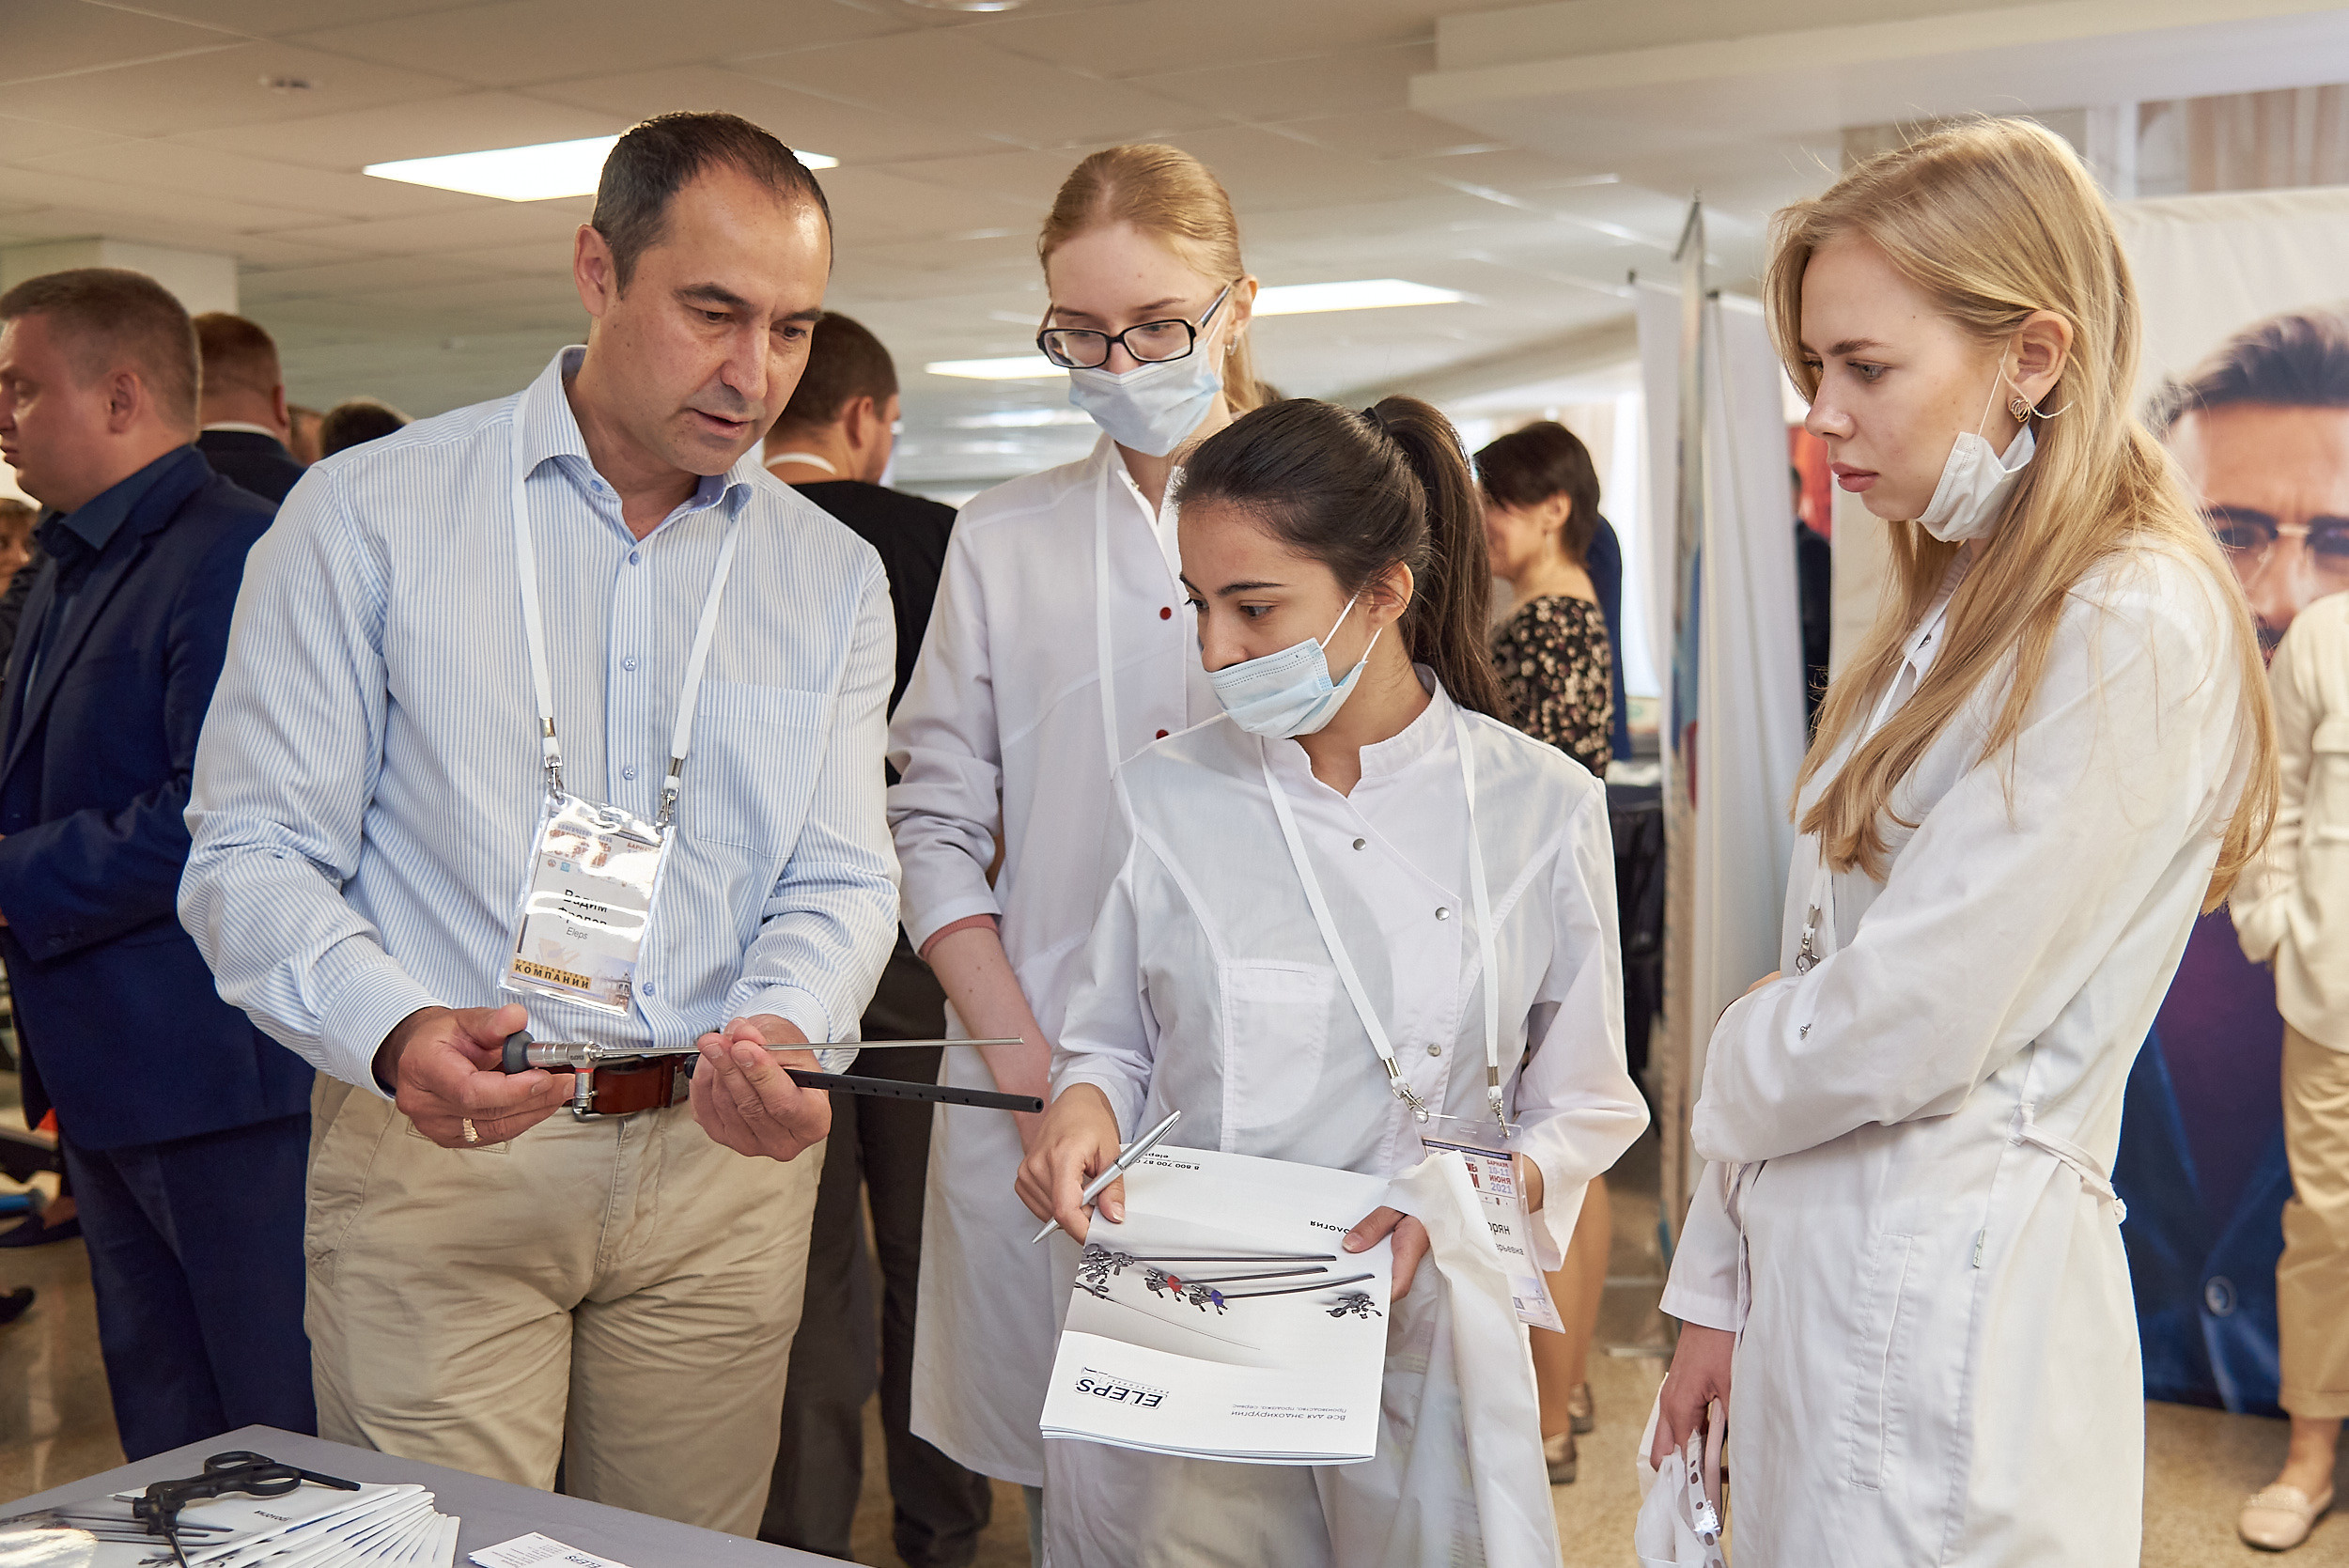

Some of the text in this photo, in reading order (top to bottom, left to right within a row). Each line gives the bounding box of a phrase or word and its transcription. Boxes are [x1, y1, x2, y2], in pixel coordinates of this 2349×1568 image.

[566, 926, 588, 940] Eleps
[515, 963, 589, 989] КОМПАНИИ
[516, 959, 590, 981] ПРЕДСТАВИТЕЛЬ
[1488, 1166, 1510, 1177] 10-11
[1489, 1174, 1512, 1186] ИЮНЯ
[1491, 1183, 1513, 1194] 2021
[1310, 1220, 1350, 1234] ология
[1076, 1378, 1163, 1407] ELEPS
[1231, 1410, 1305, 1420] эндохирургии
